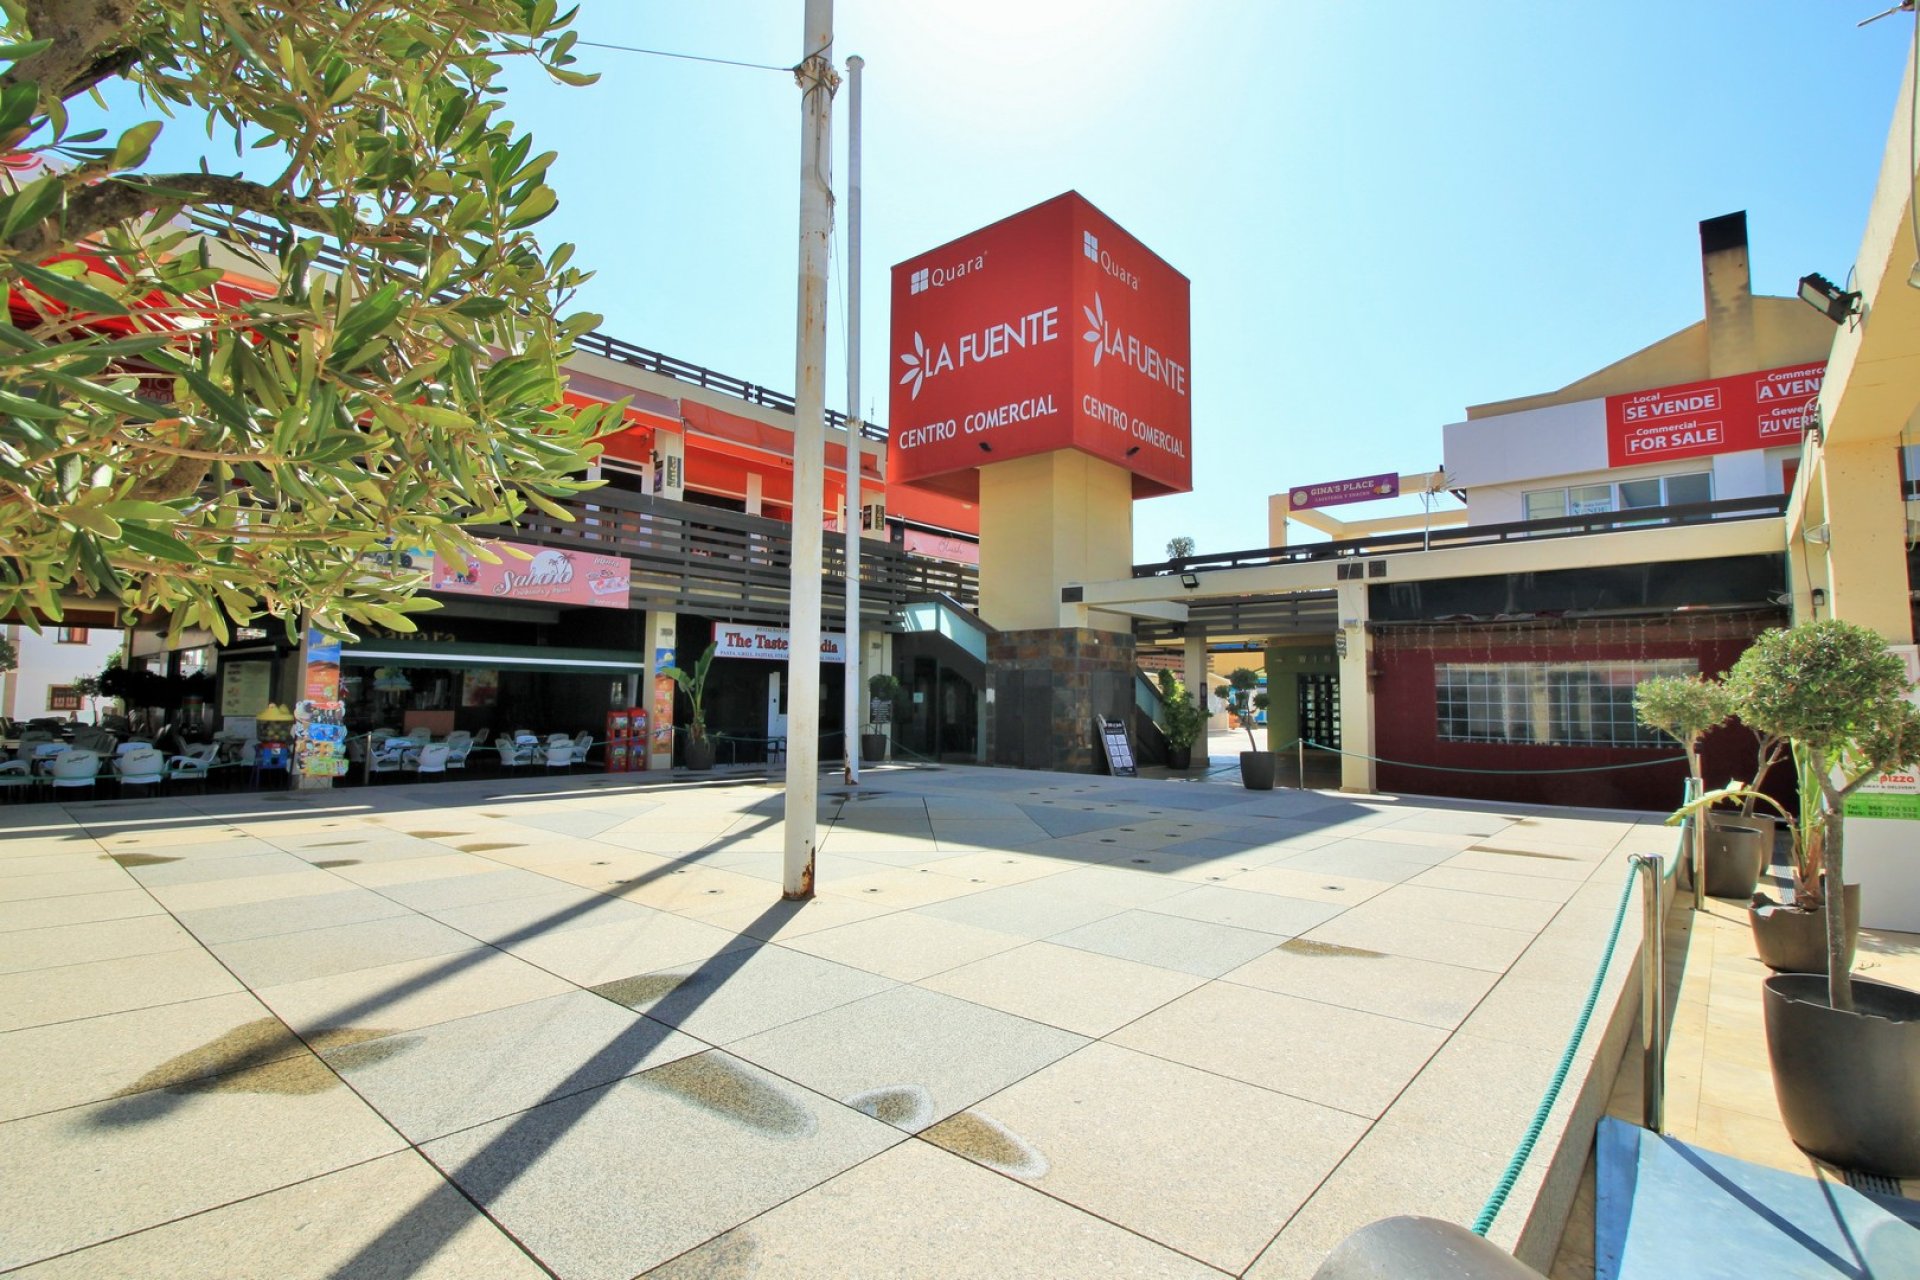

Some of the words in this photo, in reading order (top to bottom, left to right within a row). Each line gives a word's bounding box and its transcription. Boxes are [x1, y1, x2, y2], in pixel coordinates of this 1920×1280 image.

[932, 255, 984, 287] Quara
[1100, 250, 1138, 291] Quara
[924, 343, 954, 377] LA
[959, 306, 1058, 367] FUENTE
[1104, 320, 1126, 362] LA
[1129, 335, 1185, 396] FUENTE
[1633, 393, 1661, 404] Local
[1760, 385, 1774, 399] A
[1777, 378, 1824, 397] VEN
[1626, 406, 1647, 421] SE
[1651, 395, 1715, 416] VENDE
[899, 419, 957, 450] CENTRO
[964, 394, 1058, 435] COMERCIAL
[1082, 395, 1128, 432] CENTRO
[1132, 418, 1185, 459] COMERCIAL
[1636, 421, 1697, 436] Commercial
[1761, 420, 1780, 433] ZU
[1630, 436, 1667, 452] FOR
[1671, 428, 1717, 446] SALE
[1311, 485, 1341, 496] GINA'S
[1343, 480, 1375, 491] PLACE
[493, 570, 573, 596] Sahara
[725, 632, 753, 648] The
[755, 634, 789, 654] Taste
[820, 639, 839, 653] dia
